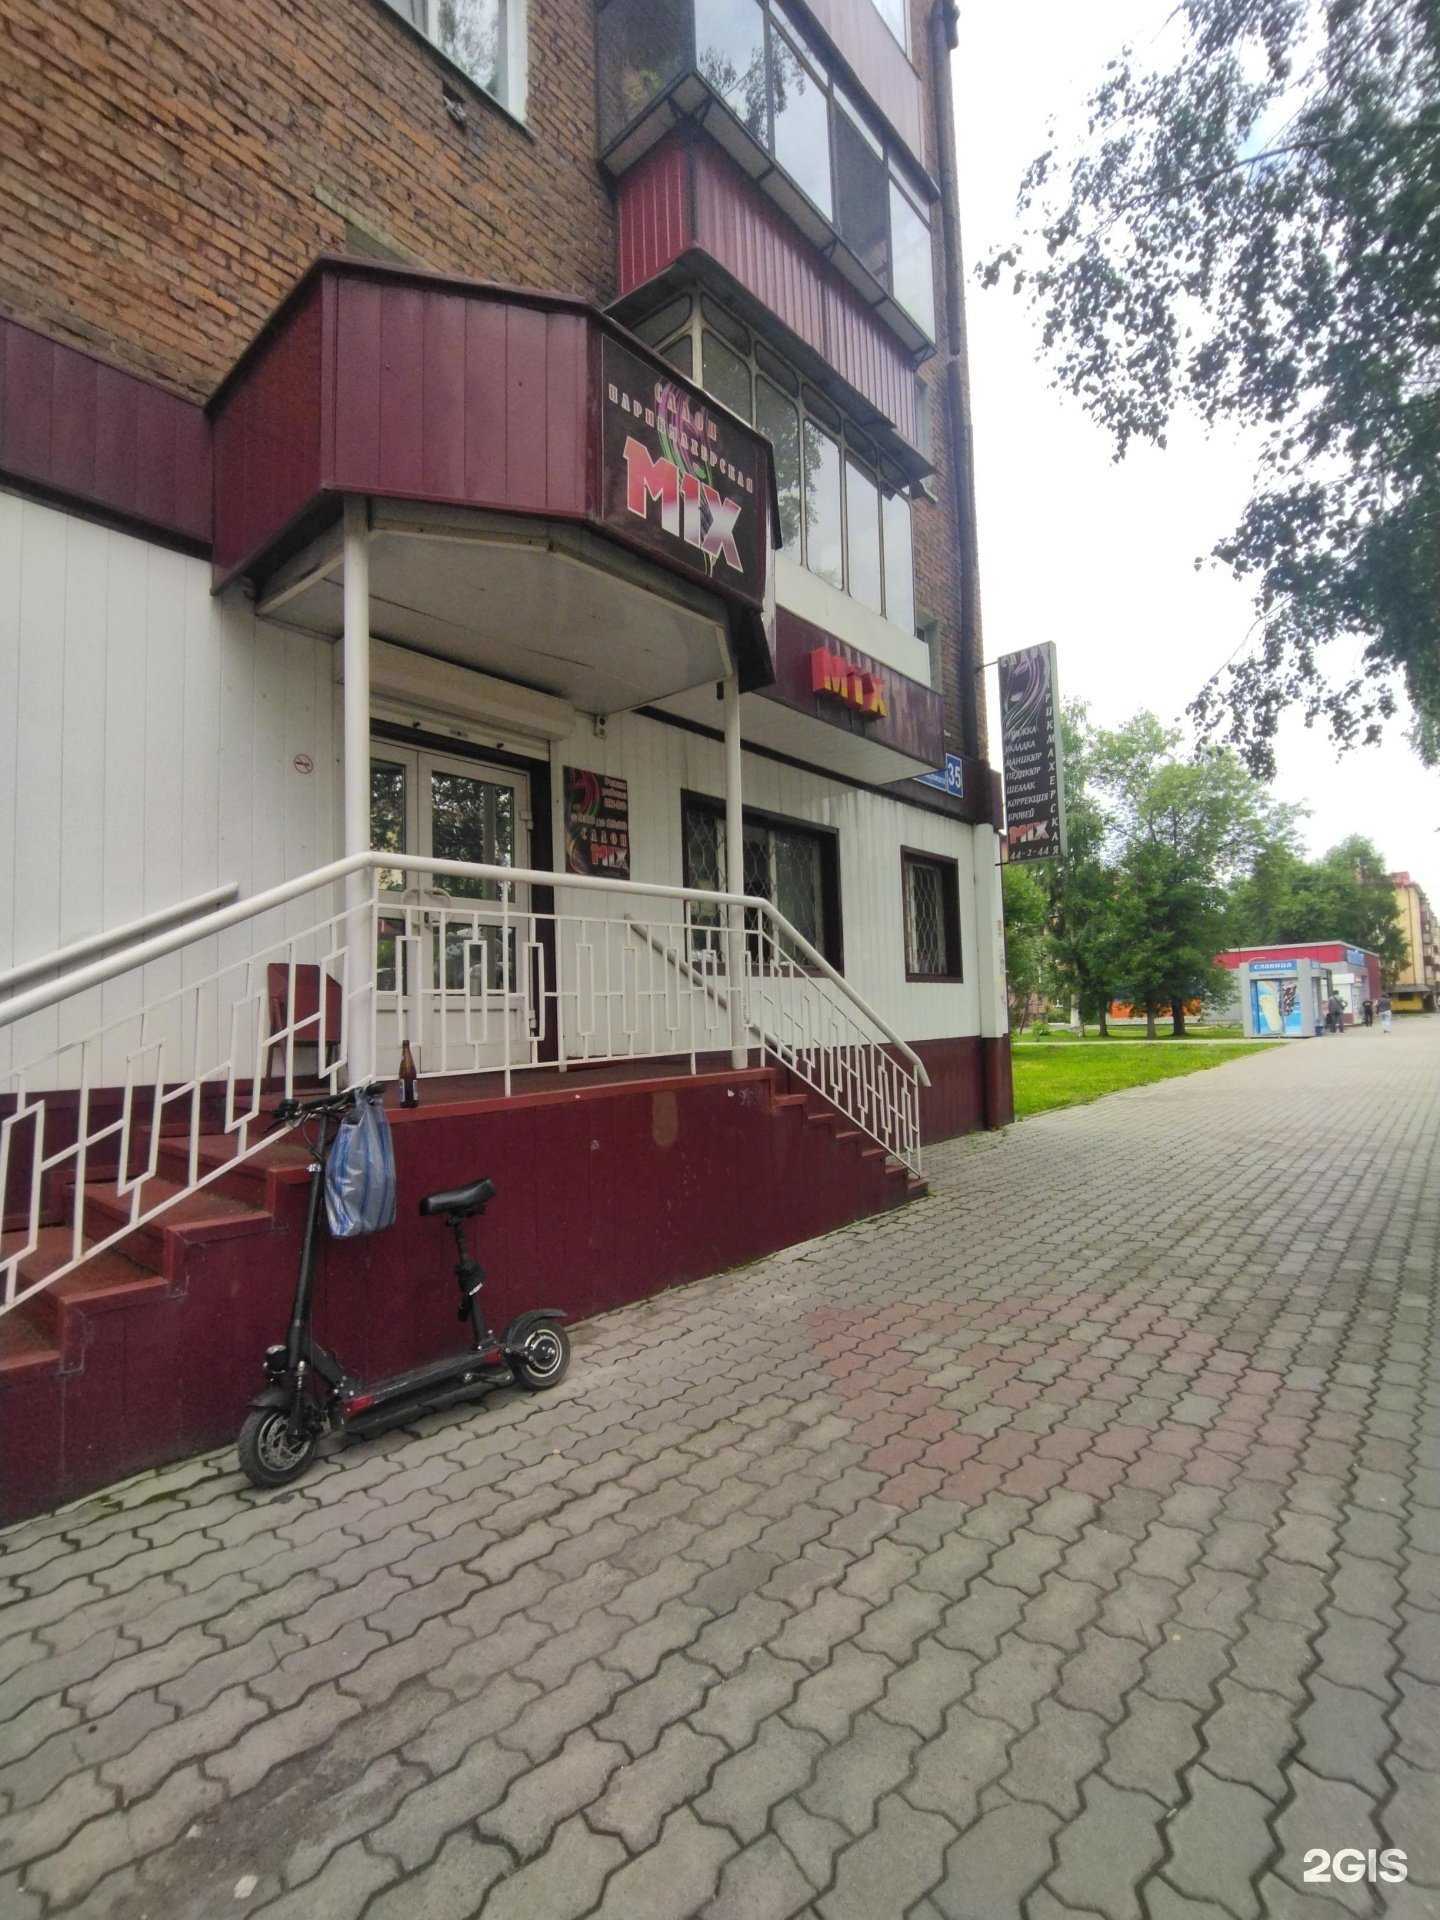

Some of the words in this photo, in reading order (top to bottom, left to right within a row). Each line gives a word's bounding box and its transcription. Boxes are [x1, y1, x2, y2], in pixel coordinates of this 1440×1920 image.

[1005, 725, 1037, 742] ТРИЖКА
[947, 761, 962, 789] 35
[1007, 792, 1049, 808] КОРРЕКЦИЯ
